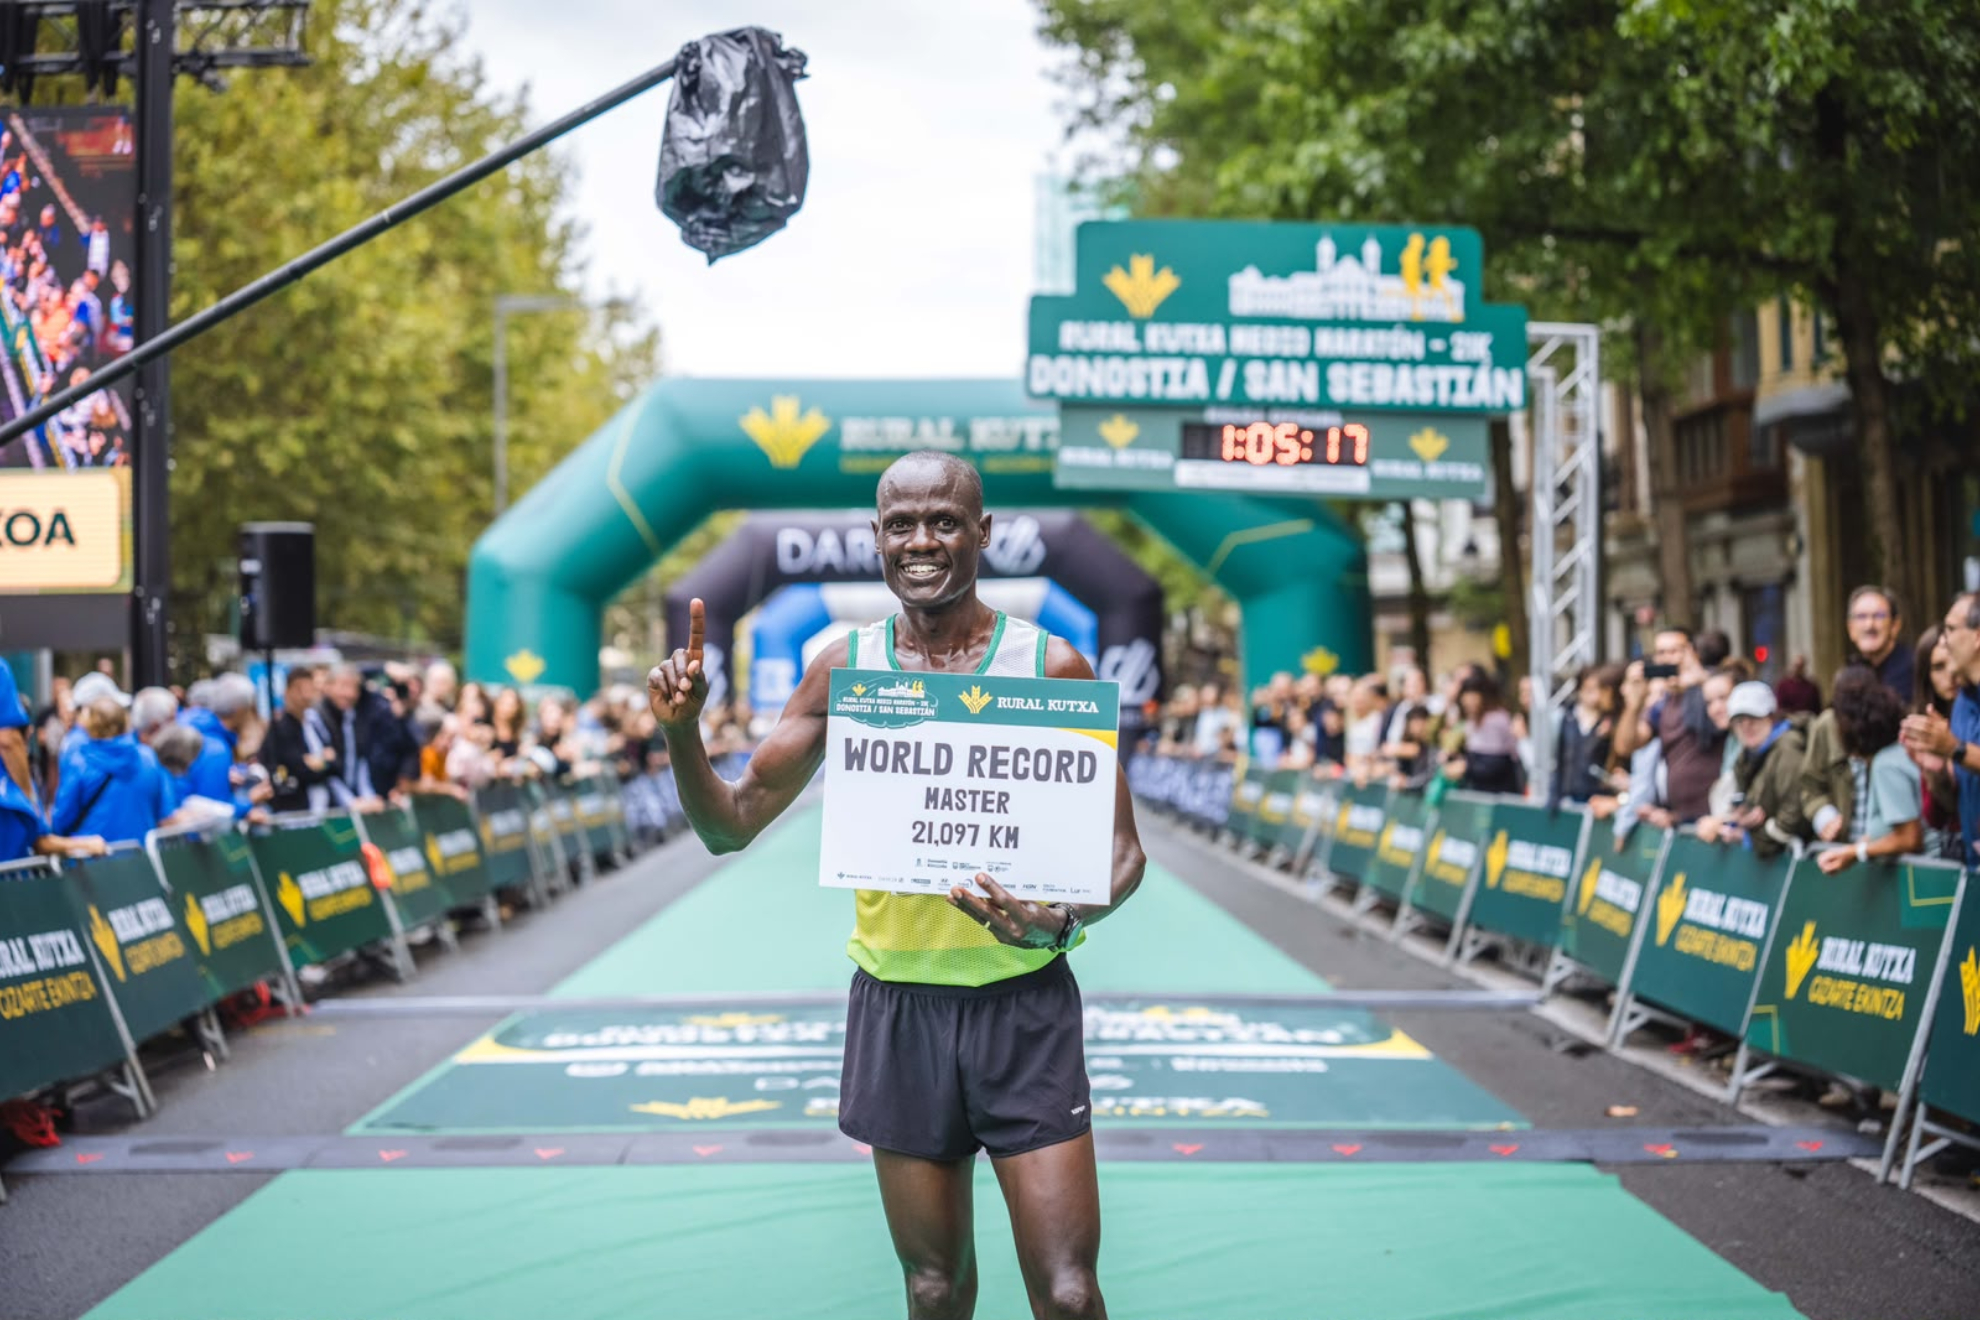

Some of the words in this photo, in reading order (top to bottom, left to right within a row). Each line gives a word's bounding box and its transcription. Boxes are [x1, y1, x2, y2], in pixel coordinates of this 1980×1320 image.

[1058, 320, 1142, 352] RURAL
[1144, 322, 1226, 354] KUTXA
[1229, 324, 1311, 358] MEDIO
[1029, 354, 1209, 398] DONOSTIA
[1216, 358, 1238, 399] /
[1243, 358, 1319, 402] SAN
[1326, 352, 1524, 408] SEBASTIÁN
[840, 416, 965, 450] RURAL
[1221, 422, 1369, 466] 1:05:17
[0, 511, 75, 546] OA
[836, 703, 872, 713] DONOSTIA
[879, 704, 893, 714] SAN
[997, 697, 1044, 710] RURAL
[1047, 699, 1099, 713] KUTXA
[844, 737, 954, 777] WORLD
[967, 745, 1097, 784] RECORD
[924, 787, 1010, 814] MASTER
[911, 821, 980, 847] 21,097
[989, 825, 1019, 849] KM
[28, 928, 86, 971] KUTXA
[1816, 935, 1865, 976] RURAL
[1862, 942, 1917, 985] KUTXA
